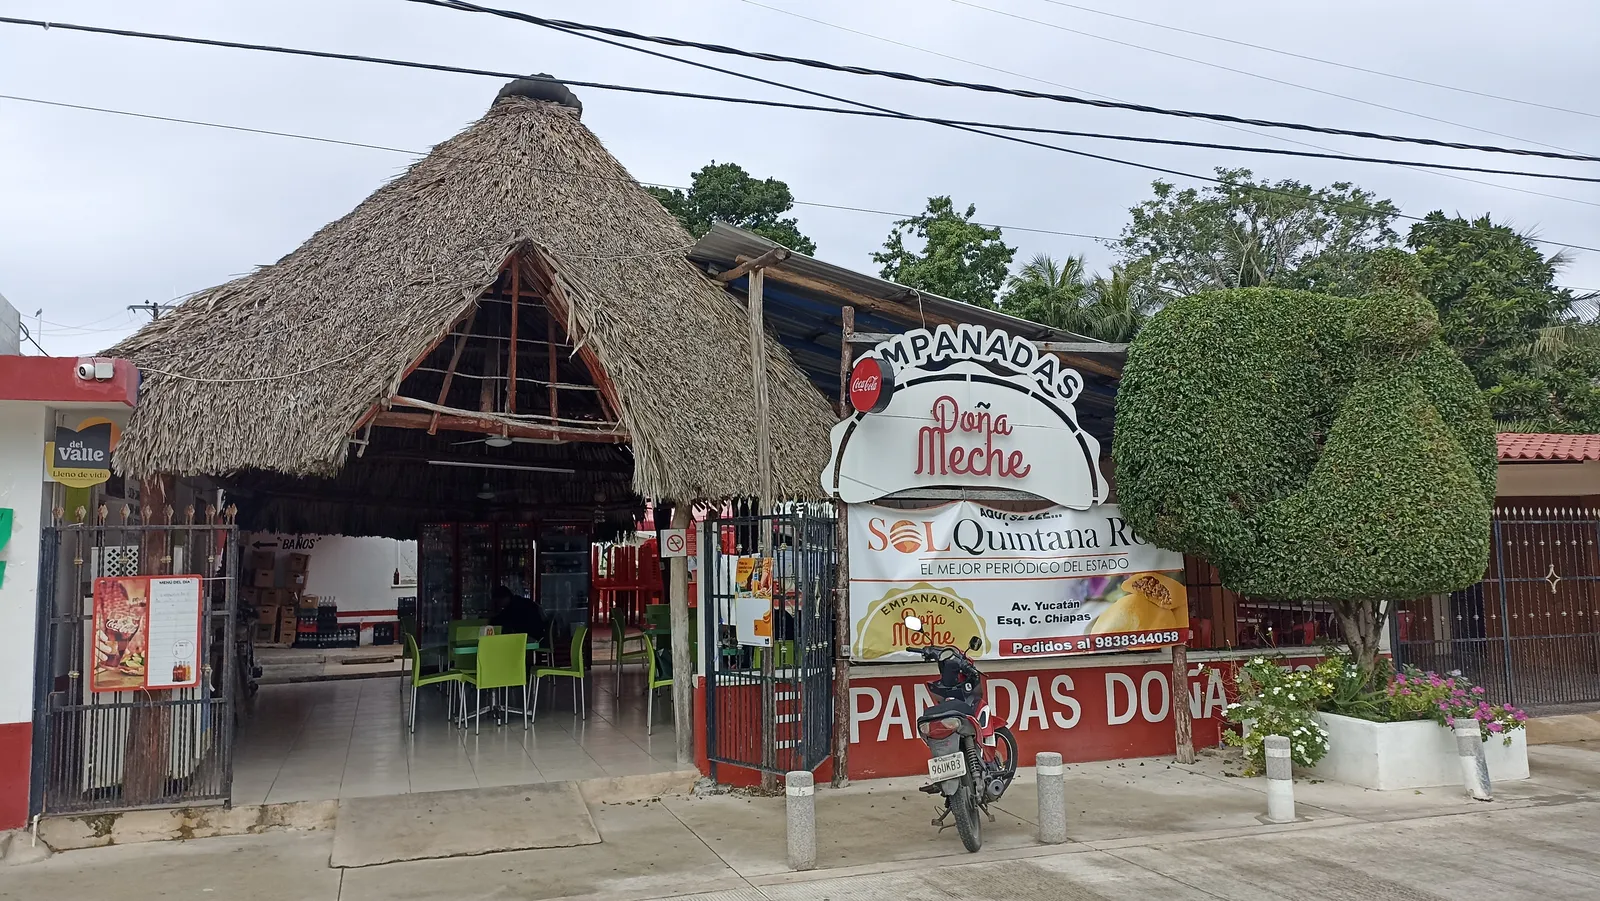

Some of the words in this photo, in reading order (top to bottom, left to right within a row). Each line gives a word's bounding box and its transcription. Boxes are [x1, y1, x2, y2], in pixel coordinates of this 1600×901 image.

[880, 329, 1079, 400] MPANADAS
[852, 375, 879, 393] Coca-Cola
[932, 395, 1013, 436] Doña
[69, 440, 83, 448] del
[914, 426, 1031, 479] Meche
[53, 470, 76, 478] Lleno
[89, 471, 107, 479] vida
[868, 517, 951, 554] SOL
[953, 518, 1100, 556] Quintana
[921, 563, 934, 575] EL
[937, 562, 981, 575] MEJOR
[985, 560, 1060, 575] PERIÓDICO
[1063, 560, 1083, 573] DEL
[1086, 557, 1129, 572] ESTADO
[880, 593, 964, 616] EMPANADAS
[1011, 602, 1031, 612] Av.
[1034, 600, 1080, 611] Yucatán
[997, 615, 1025, 627] Esq.
[1029, 615, 1041, 625] C.
[1044, 612, 1091, 625] Chiapas
[1012, 640, 1073, 654] Pedidos
[1077, 638, 1091, 650] al
[1095, 631, 1179, 648] 9838344058
[931, 759, 961, 775] 96UKB3
